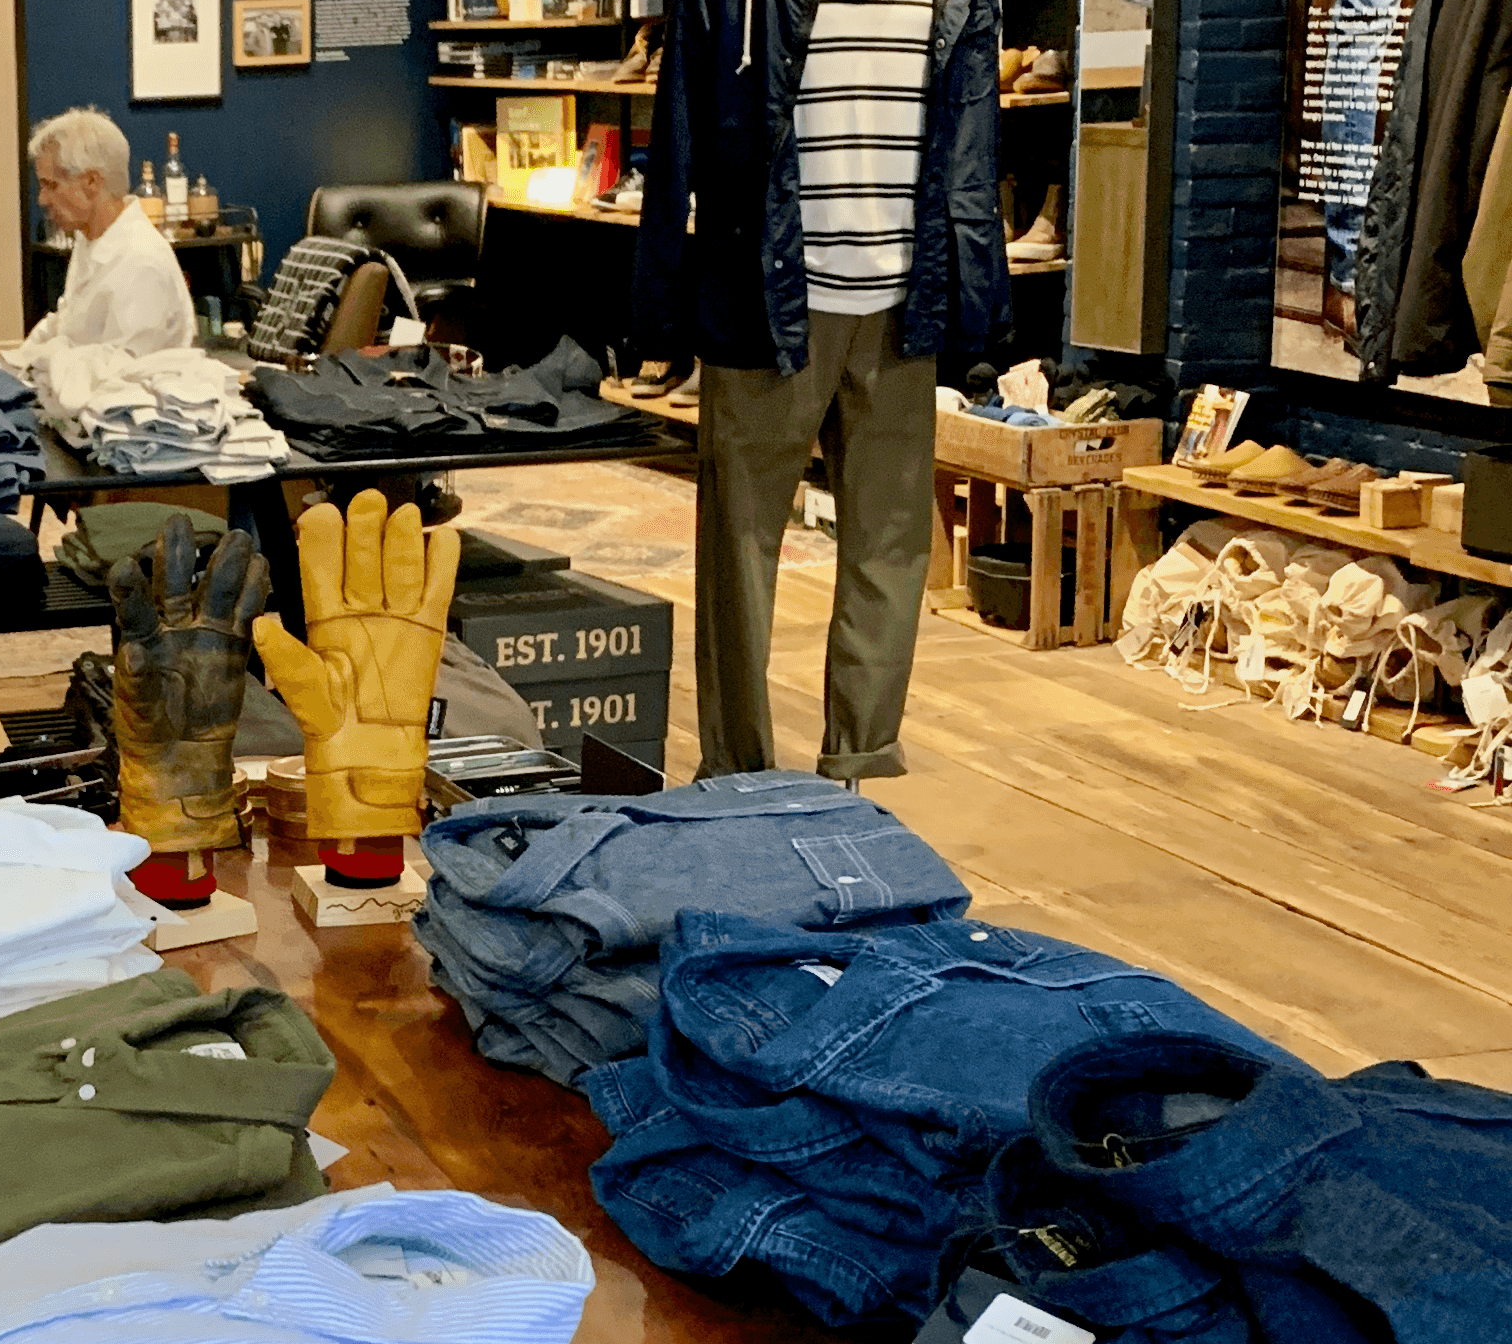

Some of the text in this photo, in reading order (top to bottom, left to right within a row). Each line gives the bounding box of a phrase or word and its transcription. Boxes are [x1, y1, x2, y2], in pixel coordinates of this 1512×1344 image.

[496, 625, 641, 668] EST. 1901
[530, 693, 637, 730] T. 1901
